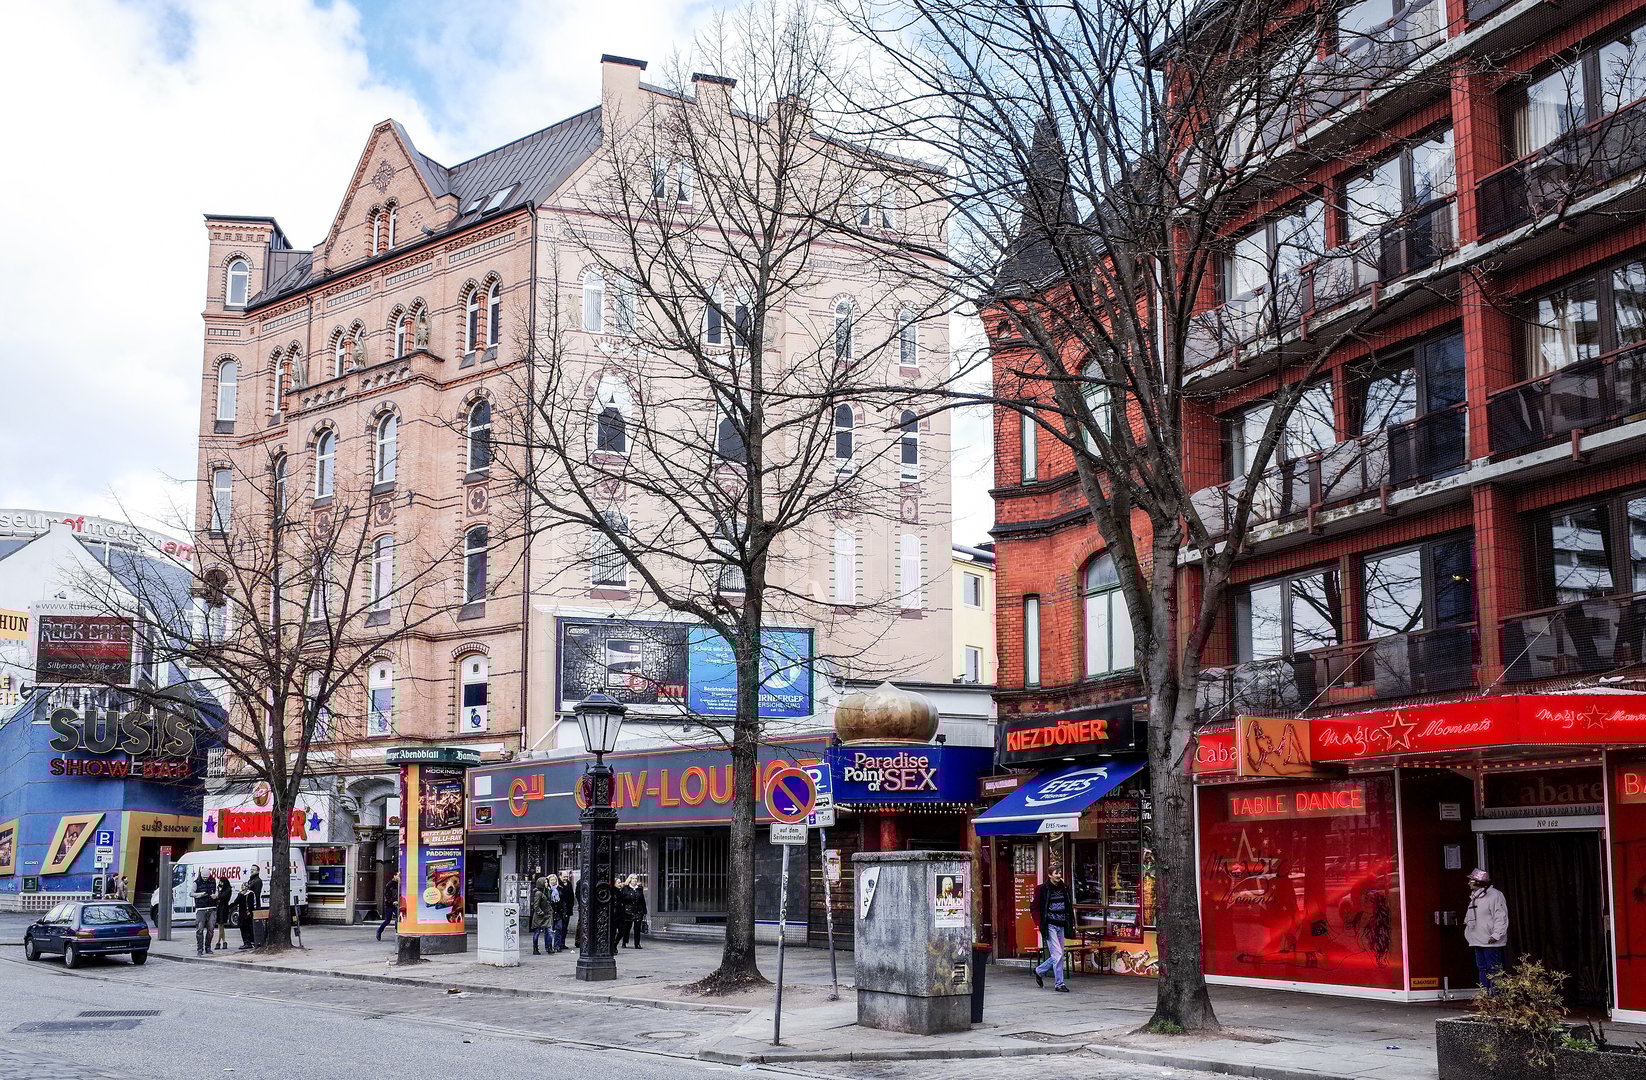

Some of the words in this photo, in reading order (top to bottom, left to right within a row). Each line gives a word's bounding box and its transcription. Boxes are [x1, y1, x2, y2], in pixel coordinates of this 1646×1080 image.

[1007, 728, 1040, 751] KIEZ
[1043, 719, 1109, 746] DÖNER
[1417, 718, 1493, 737] Moments
[400, 749, 439, 759] Abendblatt
[854, 752, 929, 769] Paradise
[50, 758, 128, 776] SHOW
[144, 759, 192, 777] BAR
[844, 767, 885, 781] Point
[884, 768, 938, 791] SEX
[868, 780, 881, 791] of
[1038, 777, 1099, 793] EFES
[1624, 773, 1646, 794] B
[1230, 795, 1288, 816] TABLE
[1296, 790, 1363, 812] DANCE
[772, 833, 805, 841] Seitenstreifen
